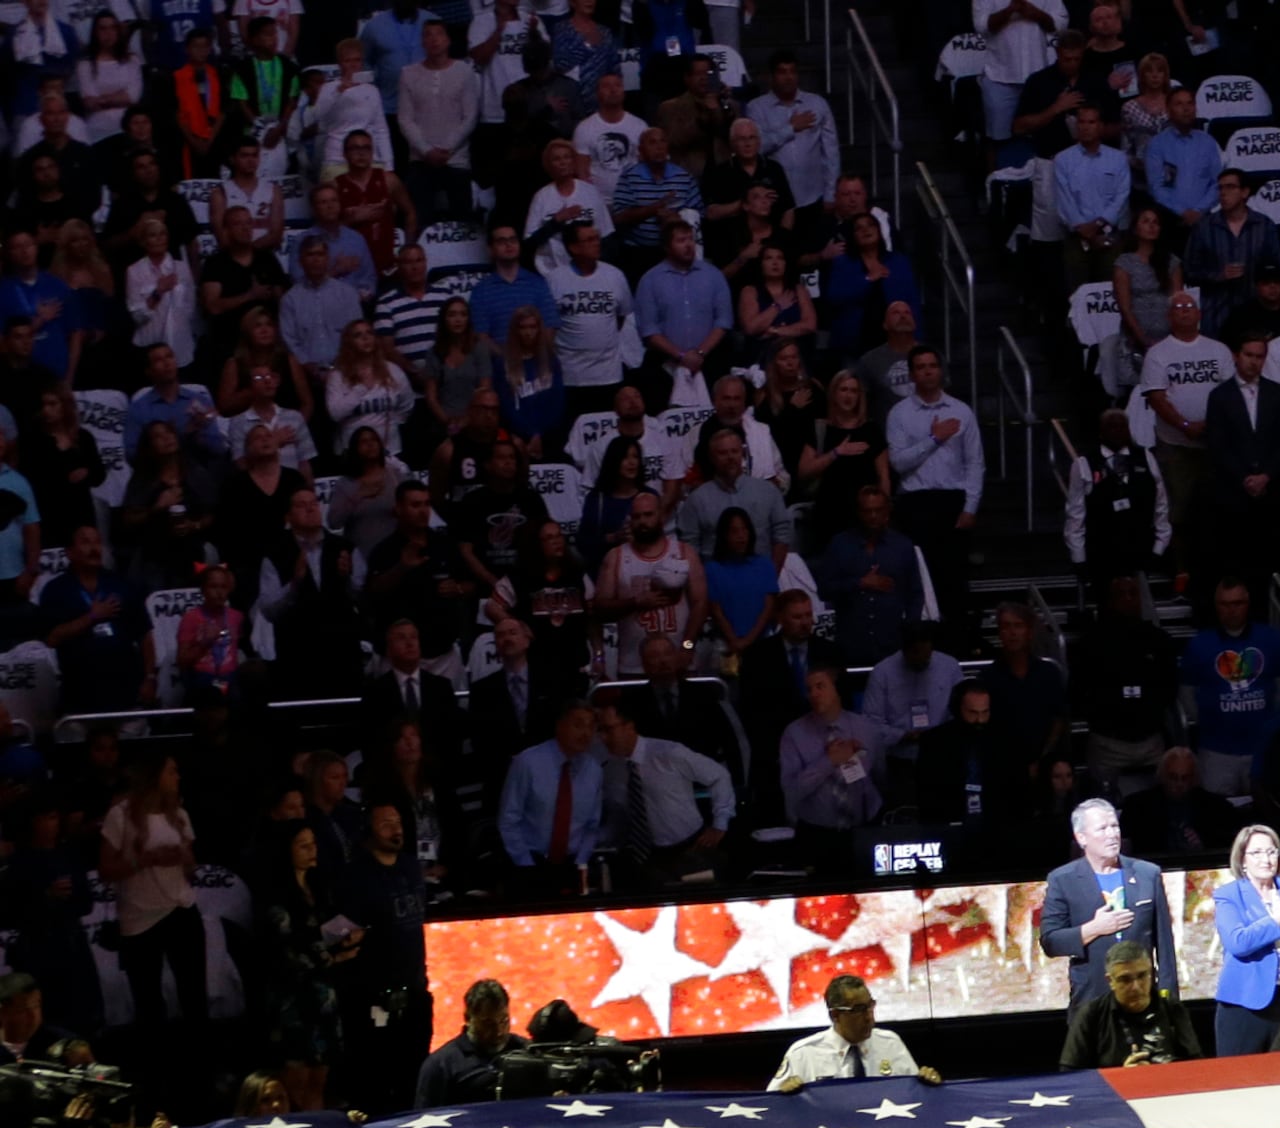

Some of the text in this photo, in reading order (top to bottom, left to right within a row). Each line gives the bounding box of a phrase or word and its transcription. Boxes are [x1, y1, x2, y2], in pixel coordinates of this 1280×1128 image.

[953, 38, 986, 50] MAG
[1220, 81, 1252, 91] PURE
[1206, 90, 1253, 103] MAGIC
[426, 229, 478, 244] MAGIC
[578, 290, 613, 301] PURE
[560, 301, 613, 315] MAGIC
[1184, 360, 1218, 371] PURE
[1168, 370, 1219, 385] MAGIC
[601, 419, 620, 431] PU
[461, 457, 478, 479] 6
[528, 469, 564, 481] PURE
[1220, 699, 1266, 712] UNITED
[893, 842, 941, 858] REPLAY
